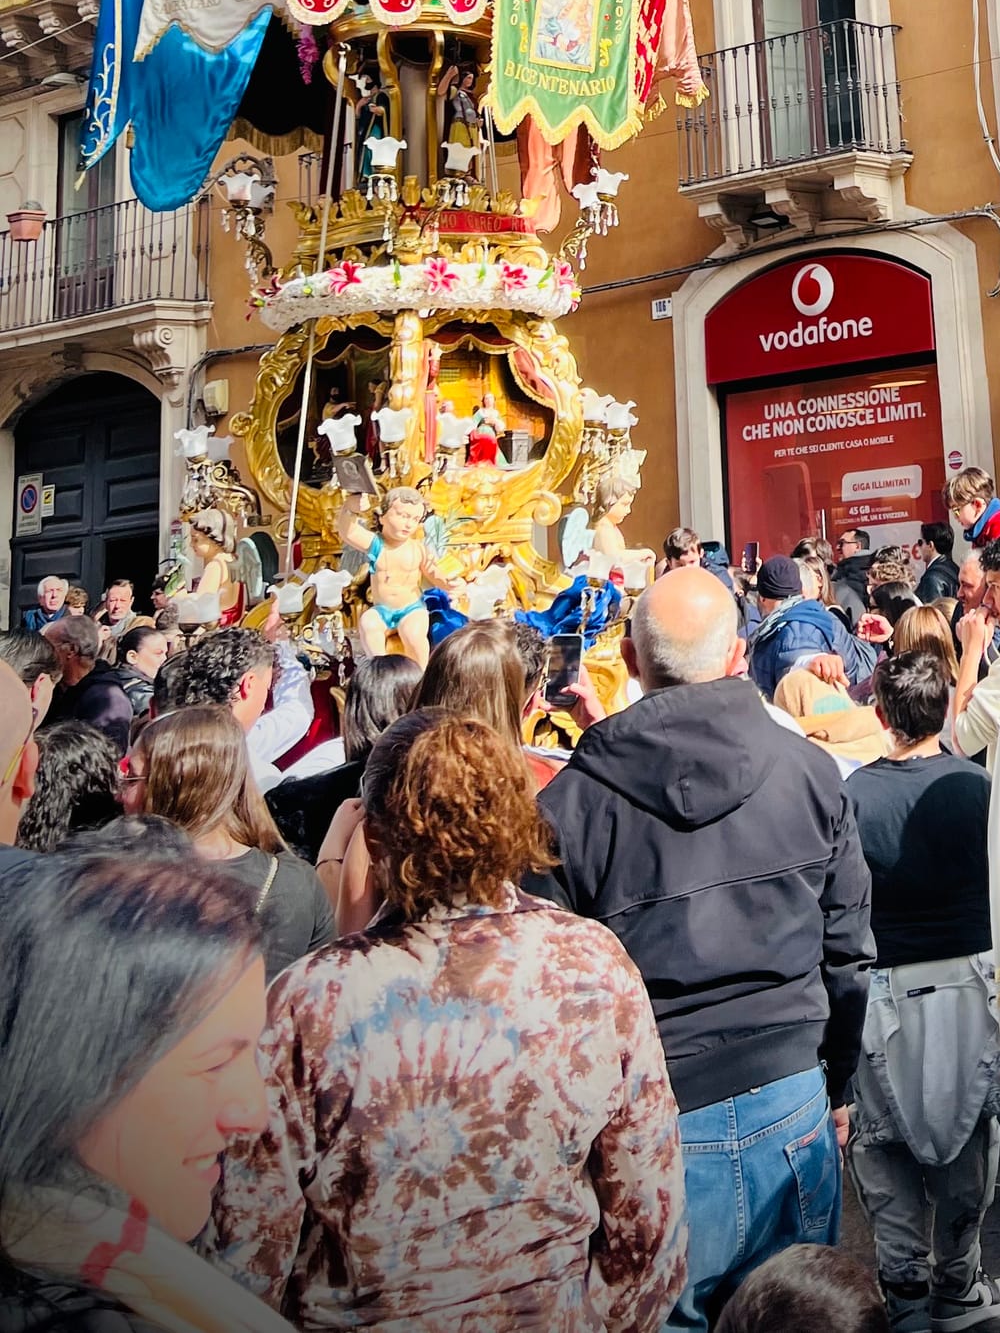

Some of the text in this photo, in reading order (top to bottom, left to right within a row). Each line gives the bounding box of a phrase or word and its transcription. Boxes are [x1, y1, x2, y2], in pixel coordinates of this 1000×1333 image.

[504, 59, 616, 97] BICENTENARIO
[759, 316, 873, 352] vodafone
[764, 387, 901, 420] UNA CONNESSIONE
[742, 402, 926, 441] CHE NON CONOSCE LIMITI.
[774, 449, 787, 458] PER
[787, 448, 796, 456] TE
[796, 446, 808, 455] CHE
[819, 442, 845, 452] CLIENTE
[846, 439, 863, 449] CASA
[869, 435, 895, 445] MOBILE
[852, 478, 911, 492] GIGA ILLIMITATI
[859, 505, 871, 514] GB
